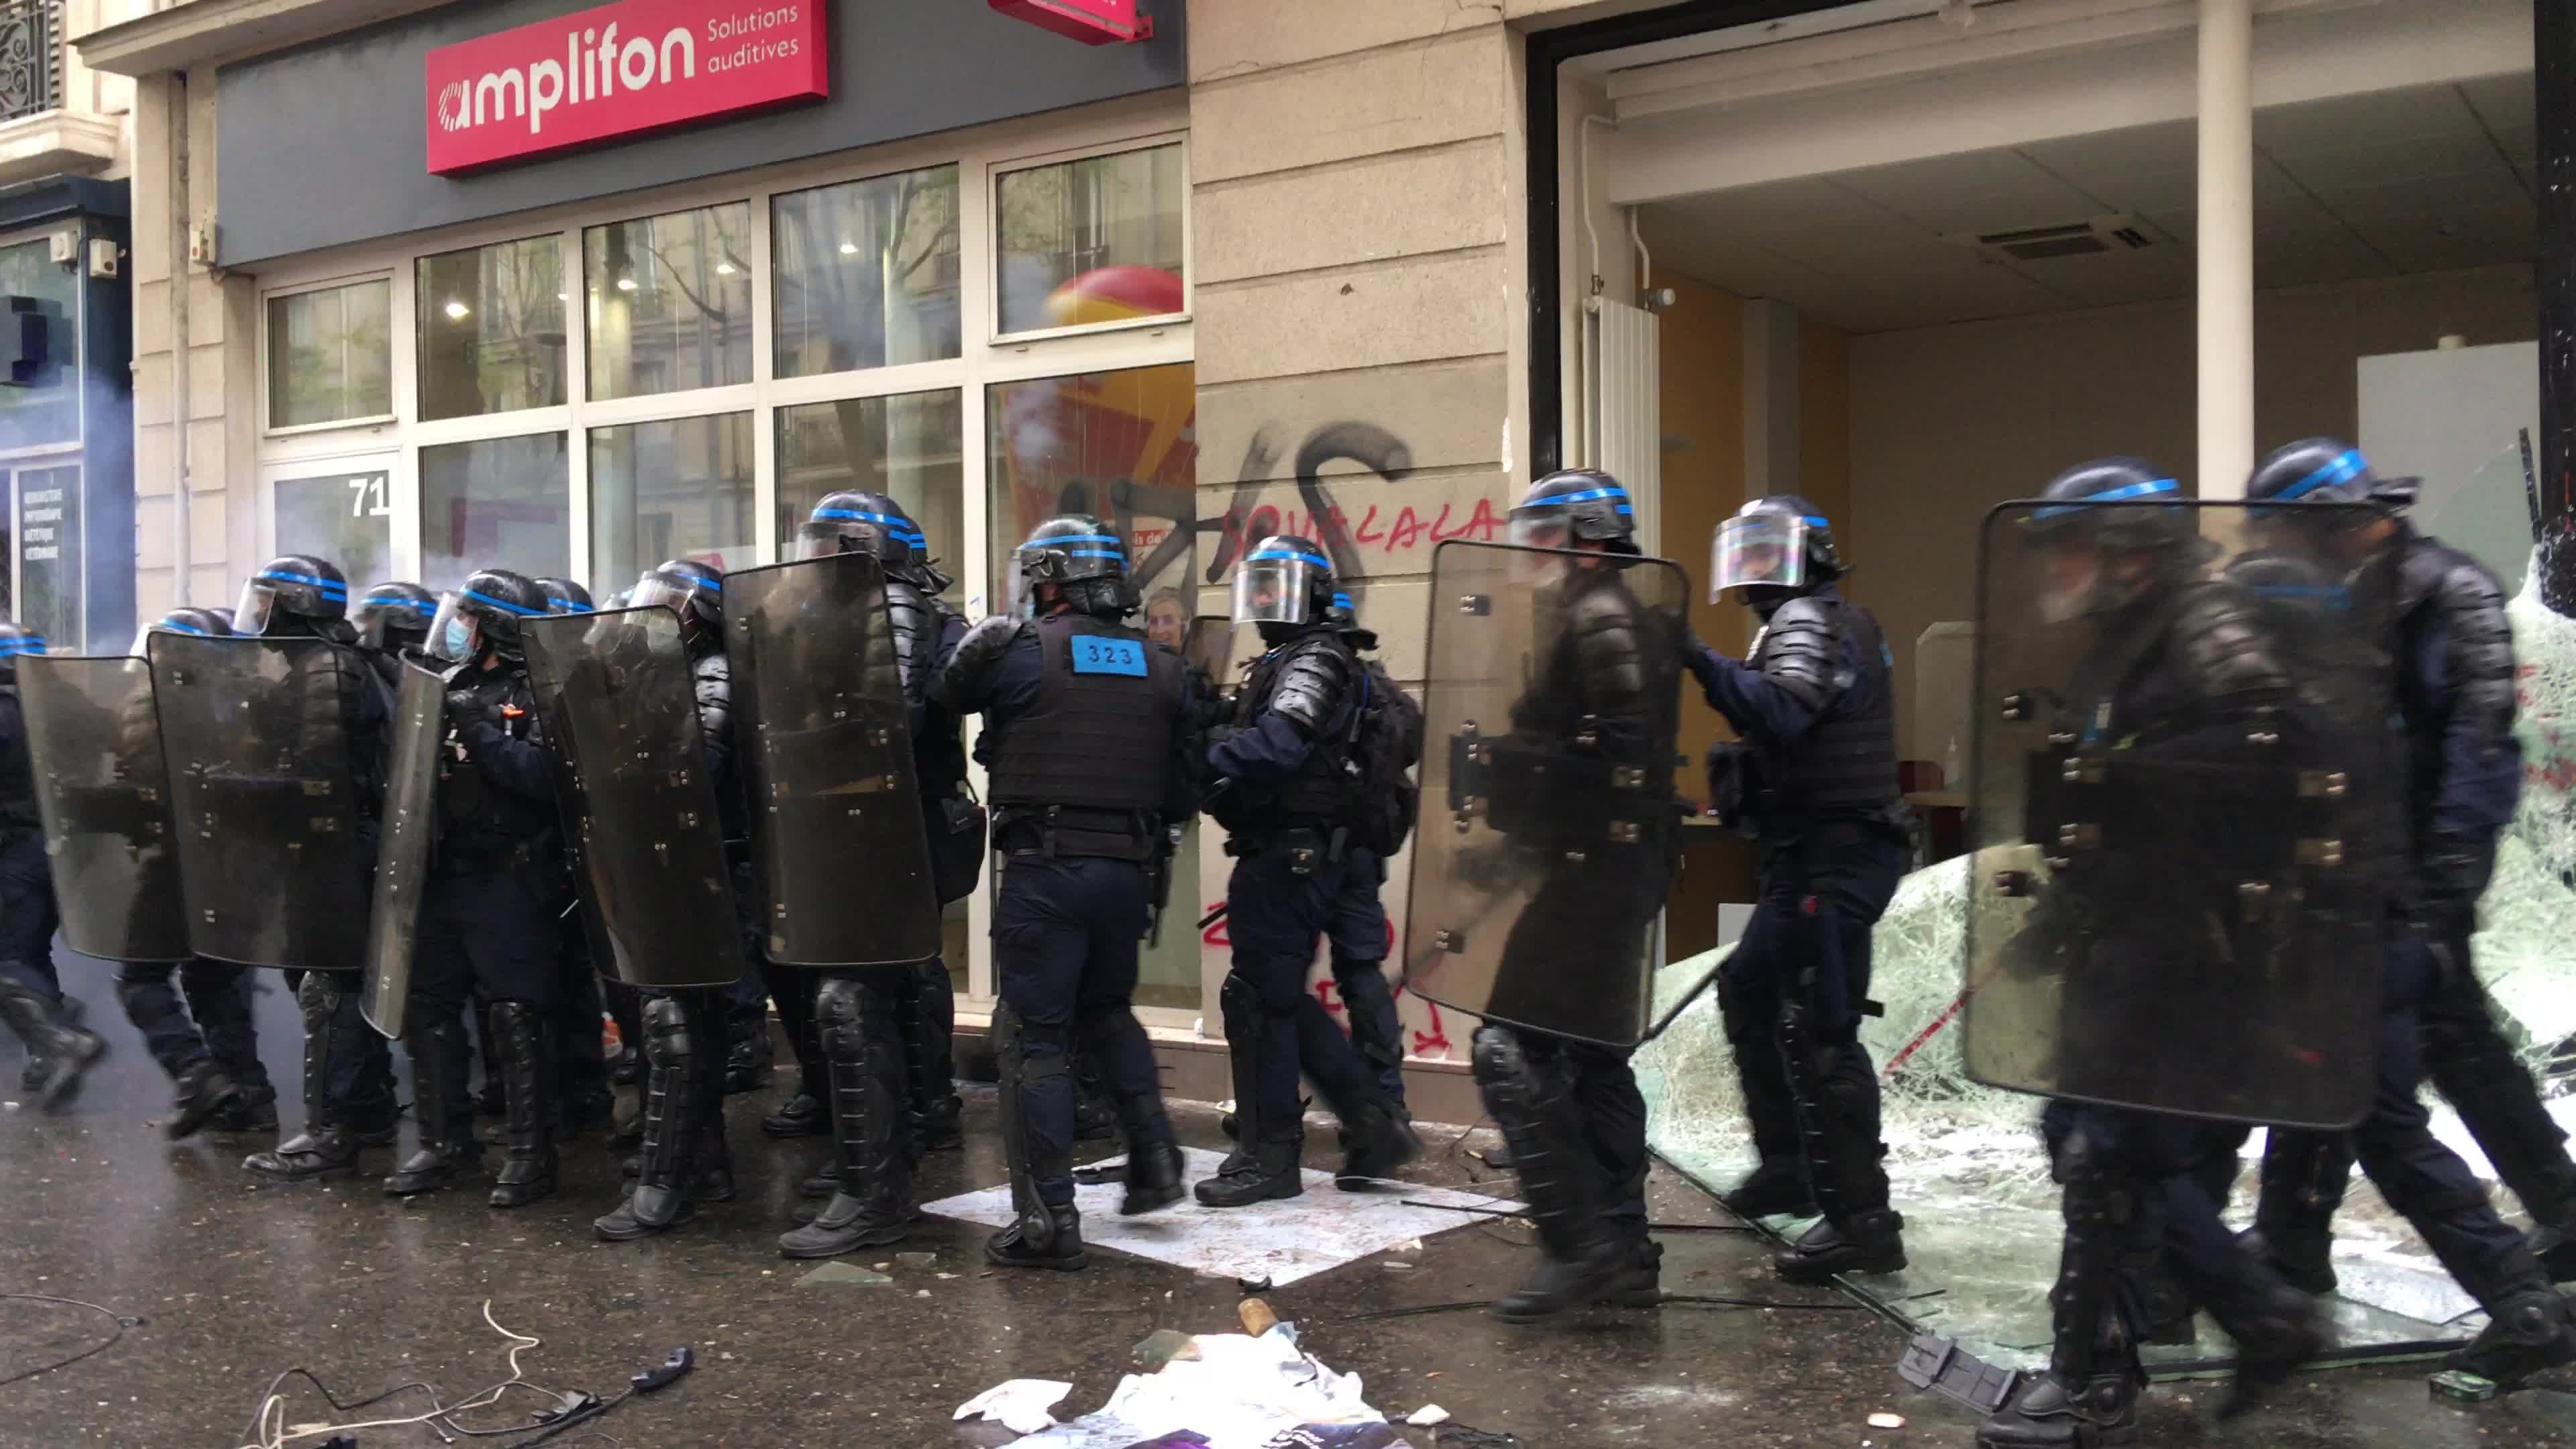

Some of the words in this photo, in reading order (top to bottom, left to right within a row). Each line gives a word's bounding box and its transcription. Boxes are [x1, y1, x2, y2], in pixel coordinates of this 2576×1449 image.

[708, 5, 798, 42] Solutions
[708, 38, 799, 73] auditives
[438, 21, 695, 133] amplifon
[349, 477, 390, 517] 71
[1088, 645, 1132, 665] 323
